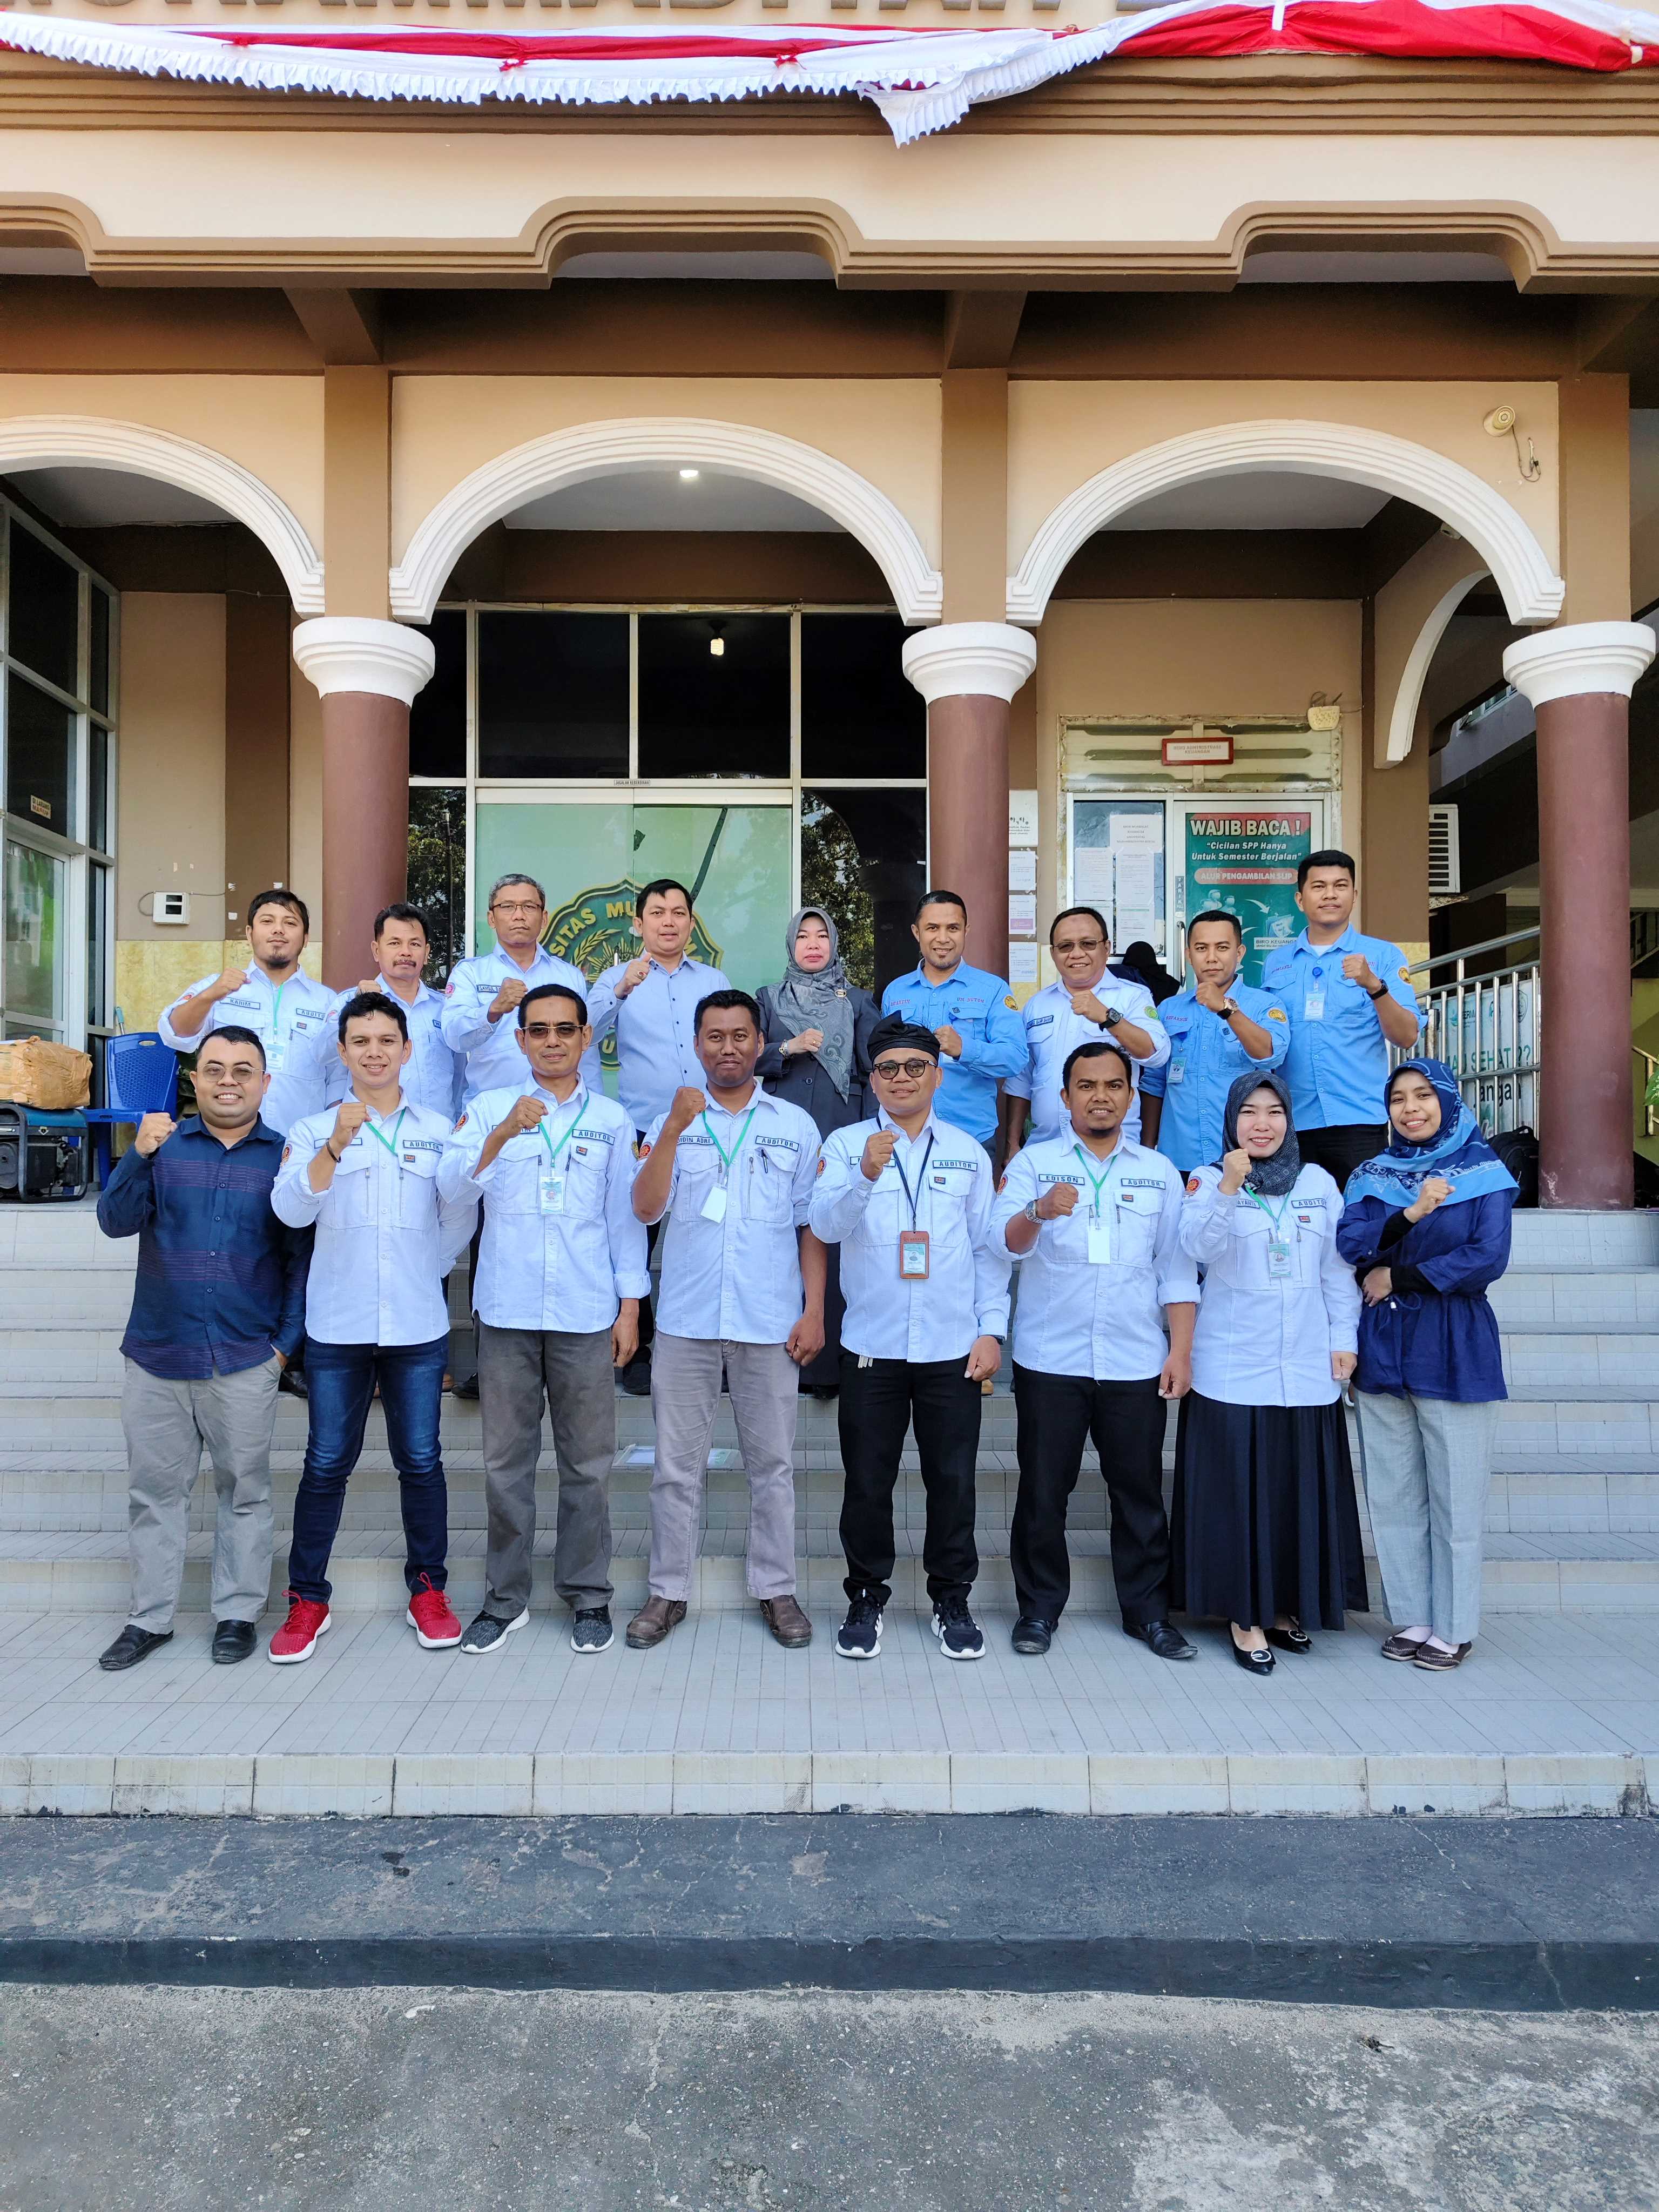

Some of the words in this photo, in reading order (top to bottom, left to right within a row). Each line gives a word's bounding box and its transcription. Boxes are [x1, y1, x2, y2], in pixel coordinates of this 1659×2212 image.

[1190, 819, 1242, 836] WAJIB
[1246, 819, 1291, 836] BACA
[1295, 819, 1301, 836] !
[1260, 842, 1286, 851] Hanya
[230, 999, 251, 1007] KARIM
[301, 1010, 325, 1019] AUDITO
[579, 1131, 610, 1142] AUDITOR
[410, 1142, 440, 1150] AUDITOR
[761, 1138, 793, 1148] AUDITOR
